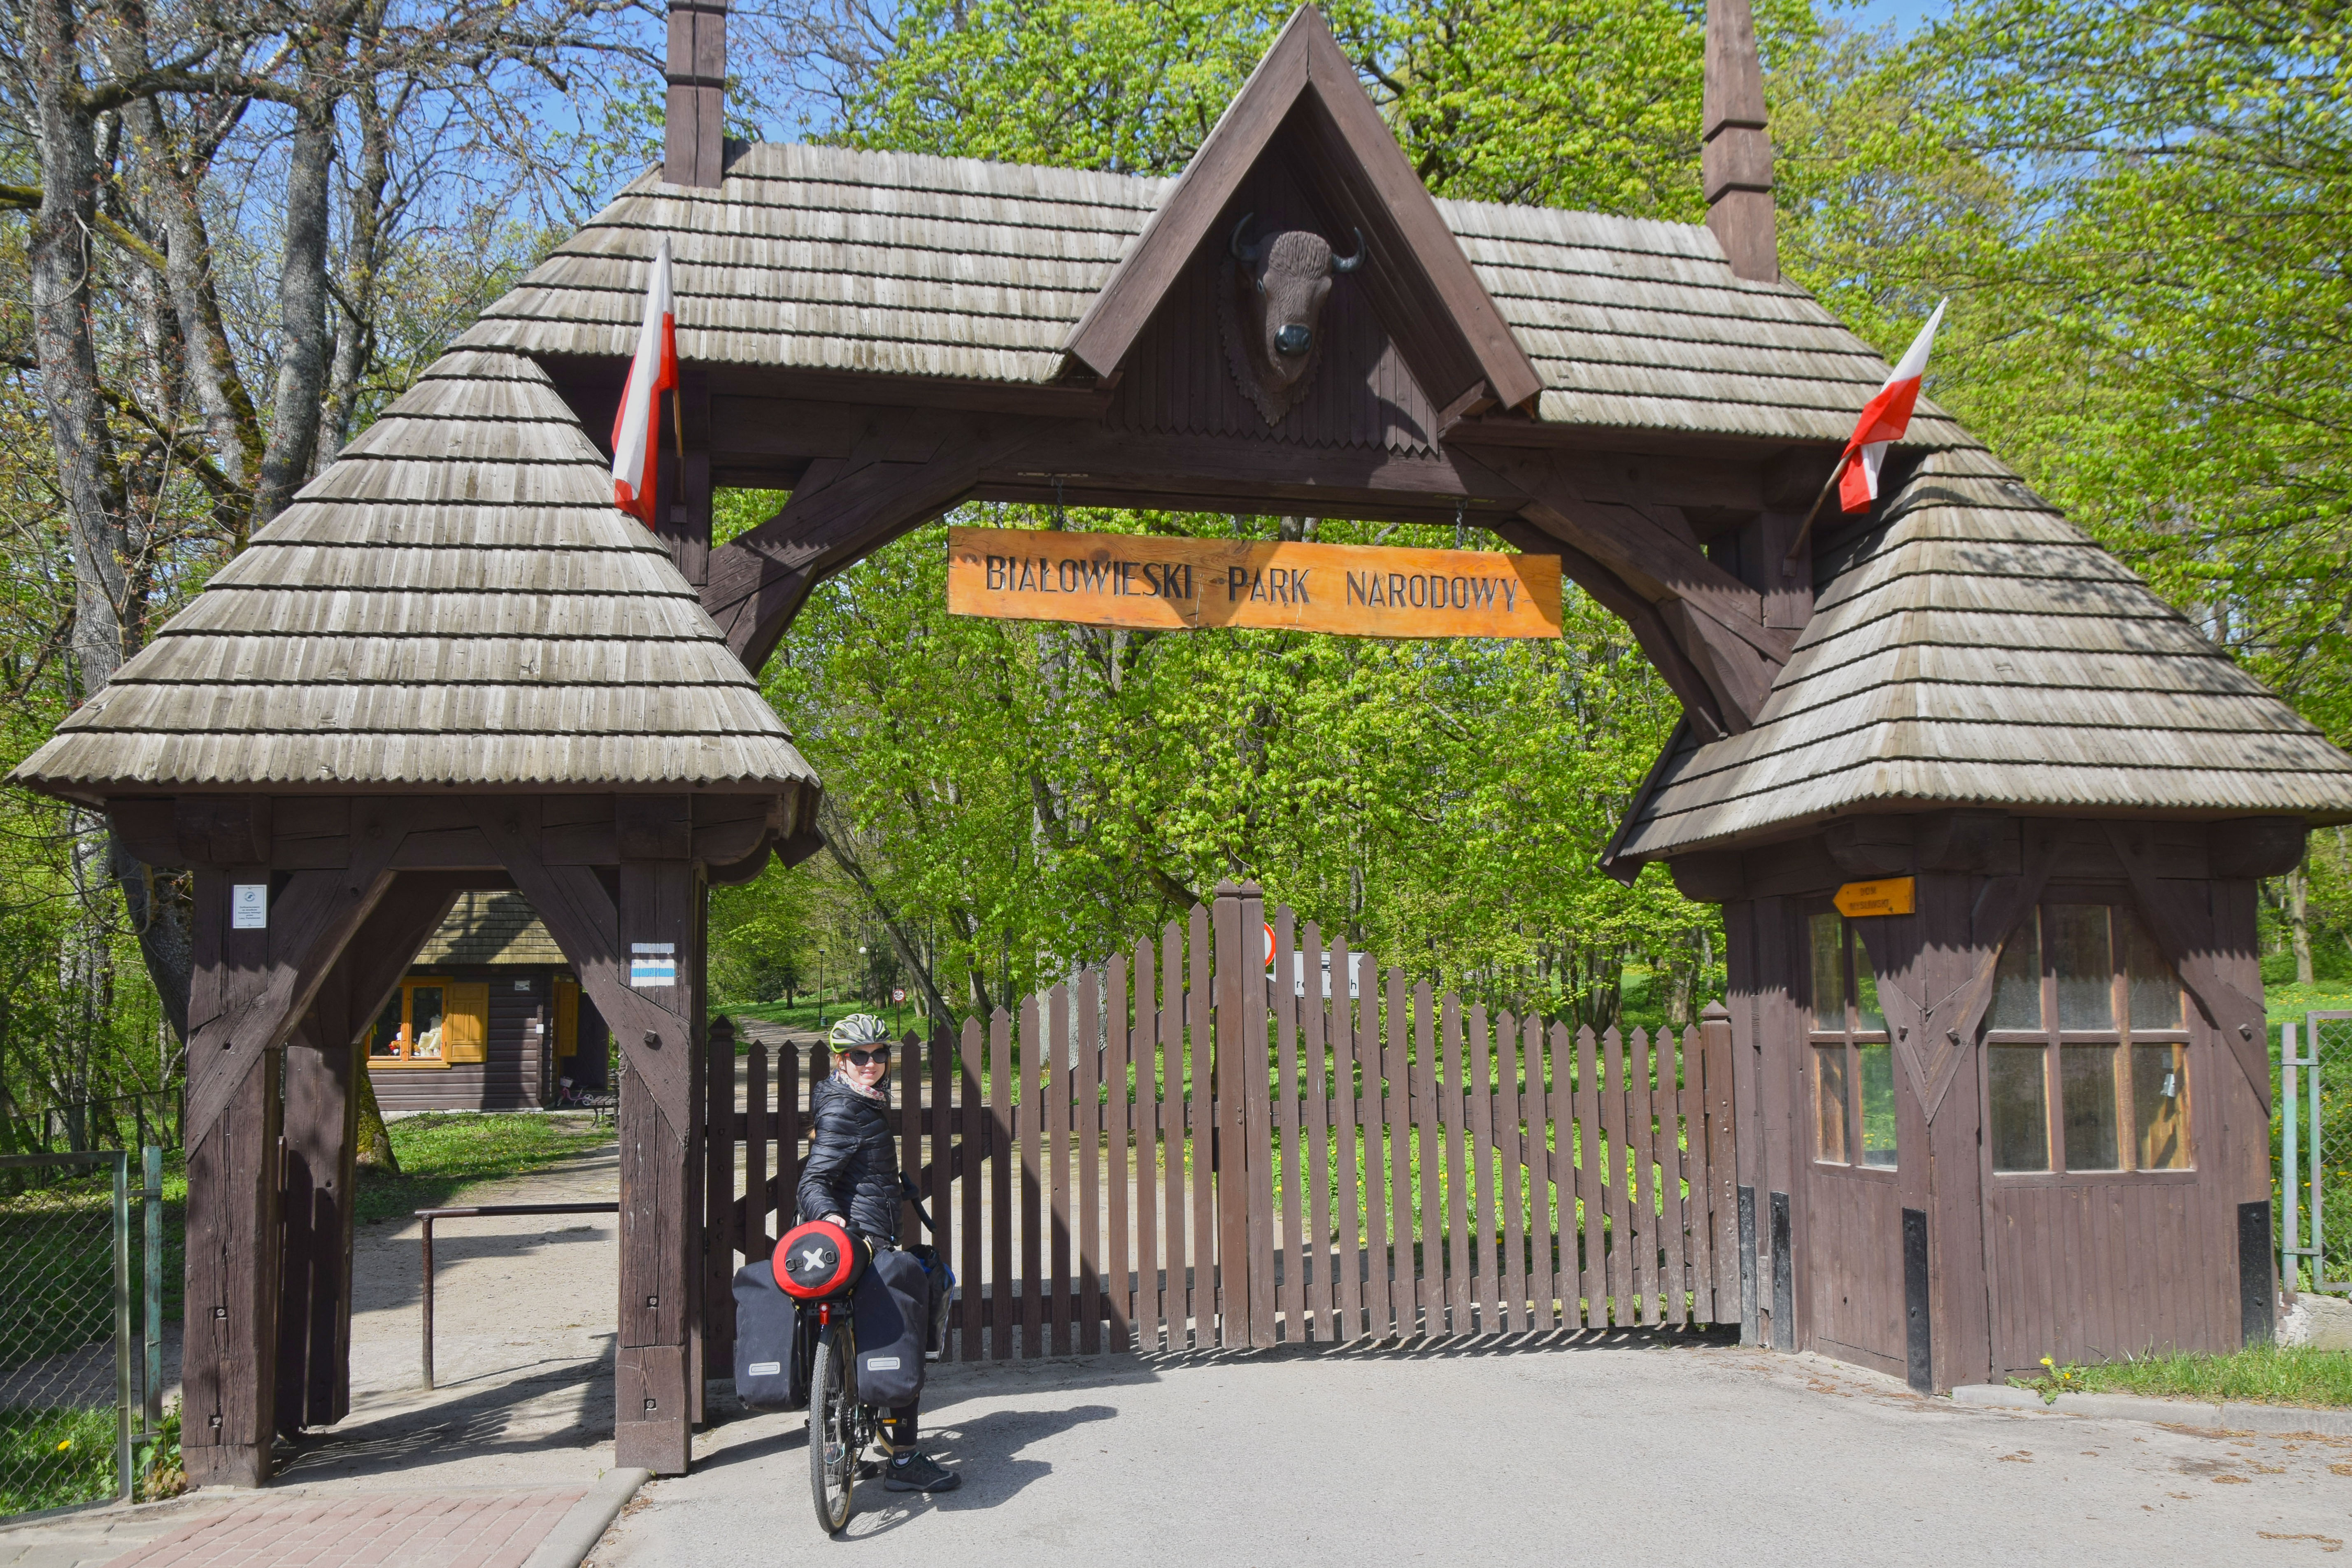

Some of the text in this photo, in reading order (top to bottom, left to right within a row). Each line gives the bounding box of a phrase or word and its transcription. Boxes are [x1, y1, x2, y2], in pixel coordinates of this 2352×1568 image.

[986, 555, 1517, 613] BIAŁOWIESKI PARK NARODOWY
[1860, 886, 1877, 896] DOM
